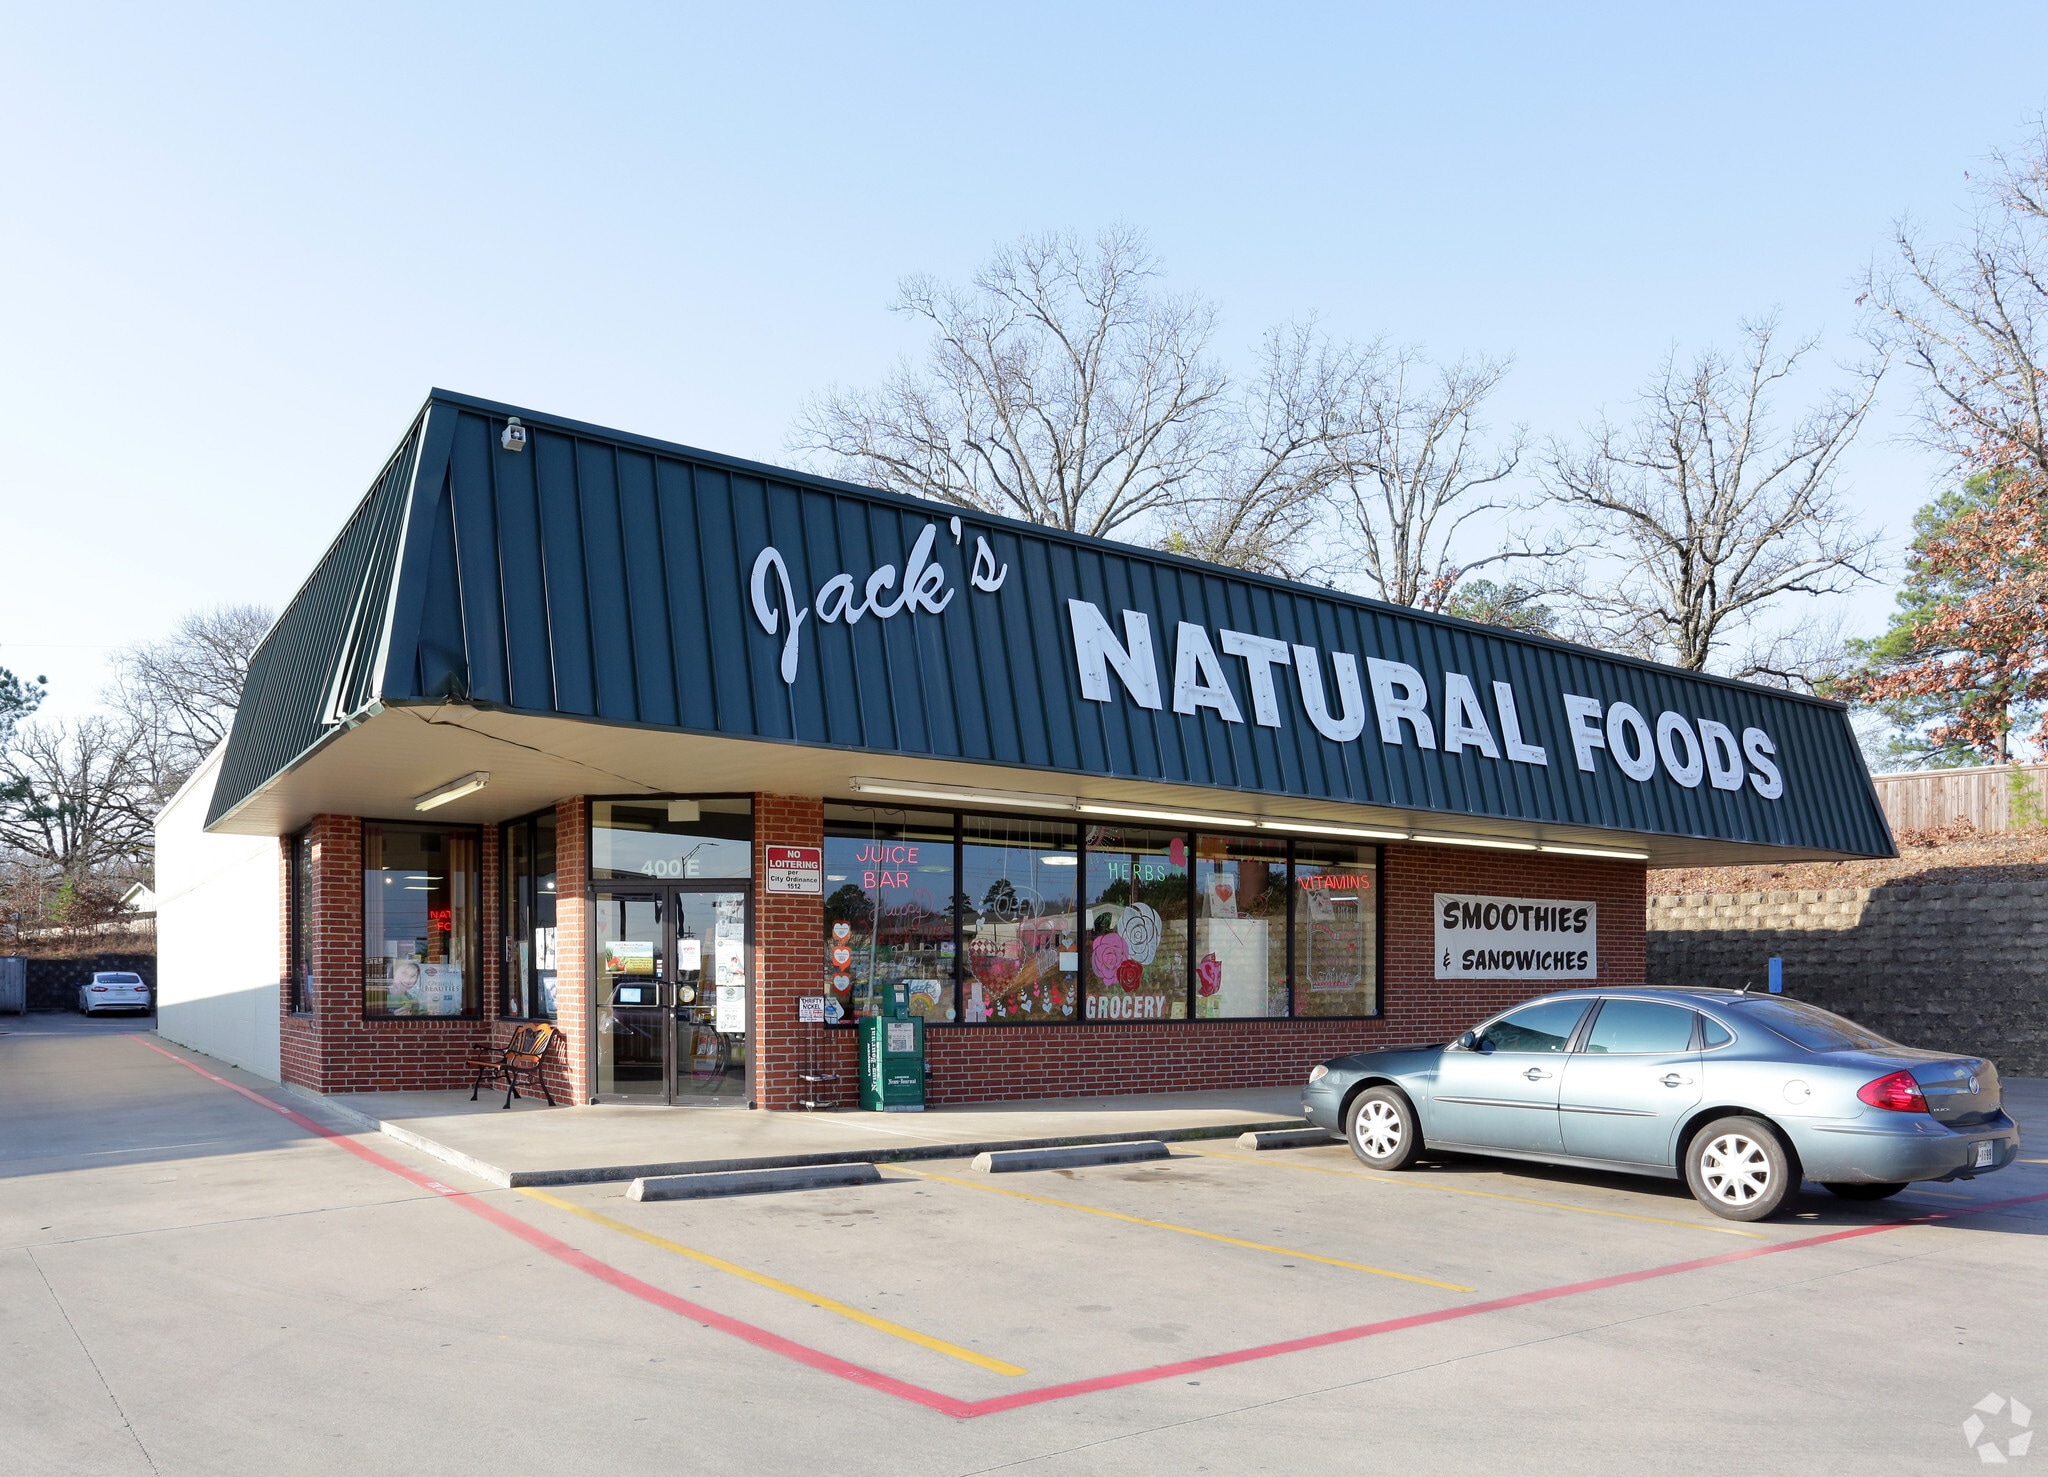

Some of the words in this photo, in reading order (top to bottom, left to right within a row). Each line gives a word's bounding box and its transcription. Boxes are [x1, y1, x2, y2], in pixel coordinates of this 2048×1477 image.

[750, 515, 1008, 684] Jack's
[1067, 598, 1548, 766] NATURAL
[1562, 693, 1784, 800] FOODS
[769, 859, 818, 869] LOITERING
[787, 850, 801, 859] NO
[856, 845, 919, 864] JUICE
[640, 859, 681, 877] 400
[686, 859, 700, 876] E
[1107, 862, 1166, 882] HERBS
[770, 875, 784, 883] City
[863, 871, 909, 889] BAR
[1298, 874, 1371, 890] VITAMINS
[1443, 901, 1589, 934] SMOOTHIES
[1442, 947, 1451, 971] &
[1462, 949, 1589, 971] SANDWICHES
[1085, 995, 1166, 1019] GROCERY
[870, 1026, 879, 1092] News-Journal
